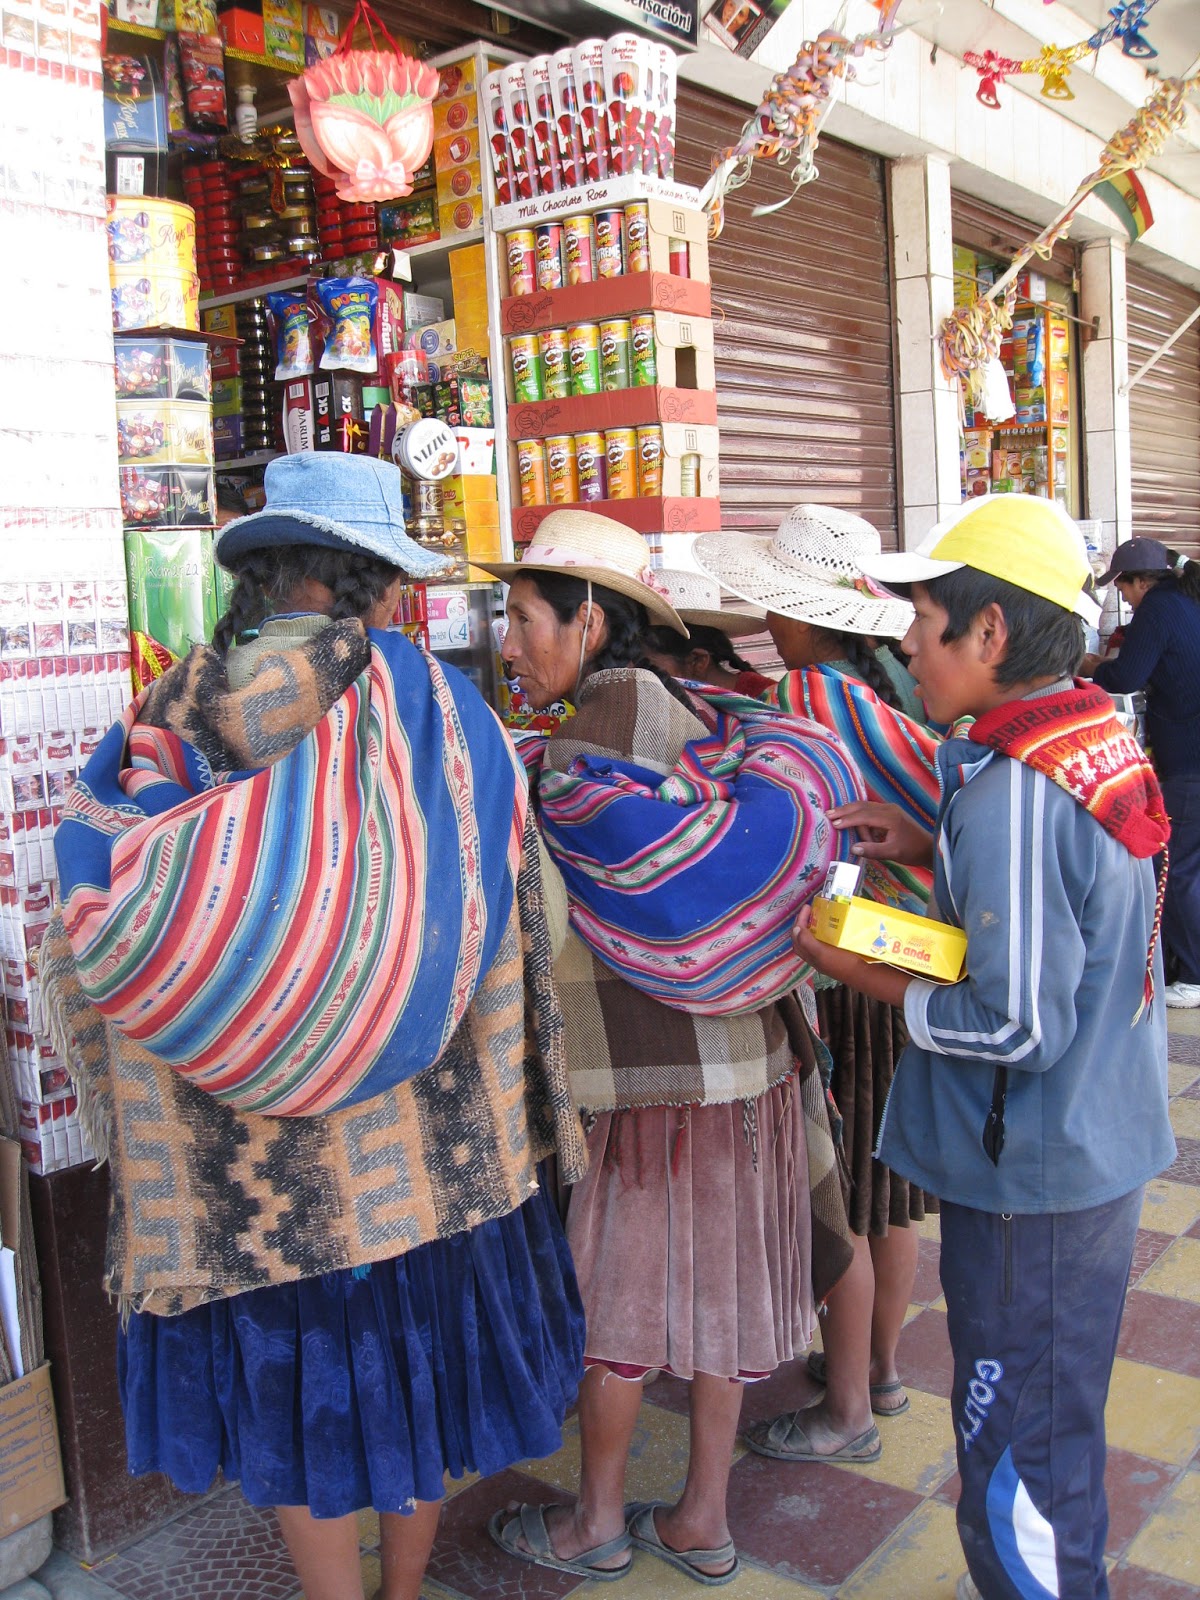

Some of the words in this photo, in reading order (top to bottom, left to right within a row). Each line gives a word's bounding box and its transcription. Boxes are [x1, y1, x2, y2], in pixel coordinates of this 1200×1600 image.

[518, 204, 539, 219] Milk
[543, 194, 582, 212] Chocolate
[587, 188, 608, 200] Rose
[146, 556, 200, 578] Romanza
[458, 623, 468, 640] 4
